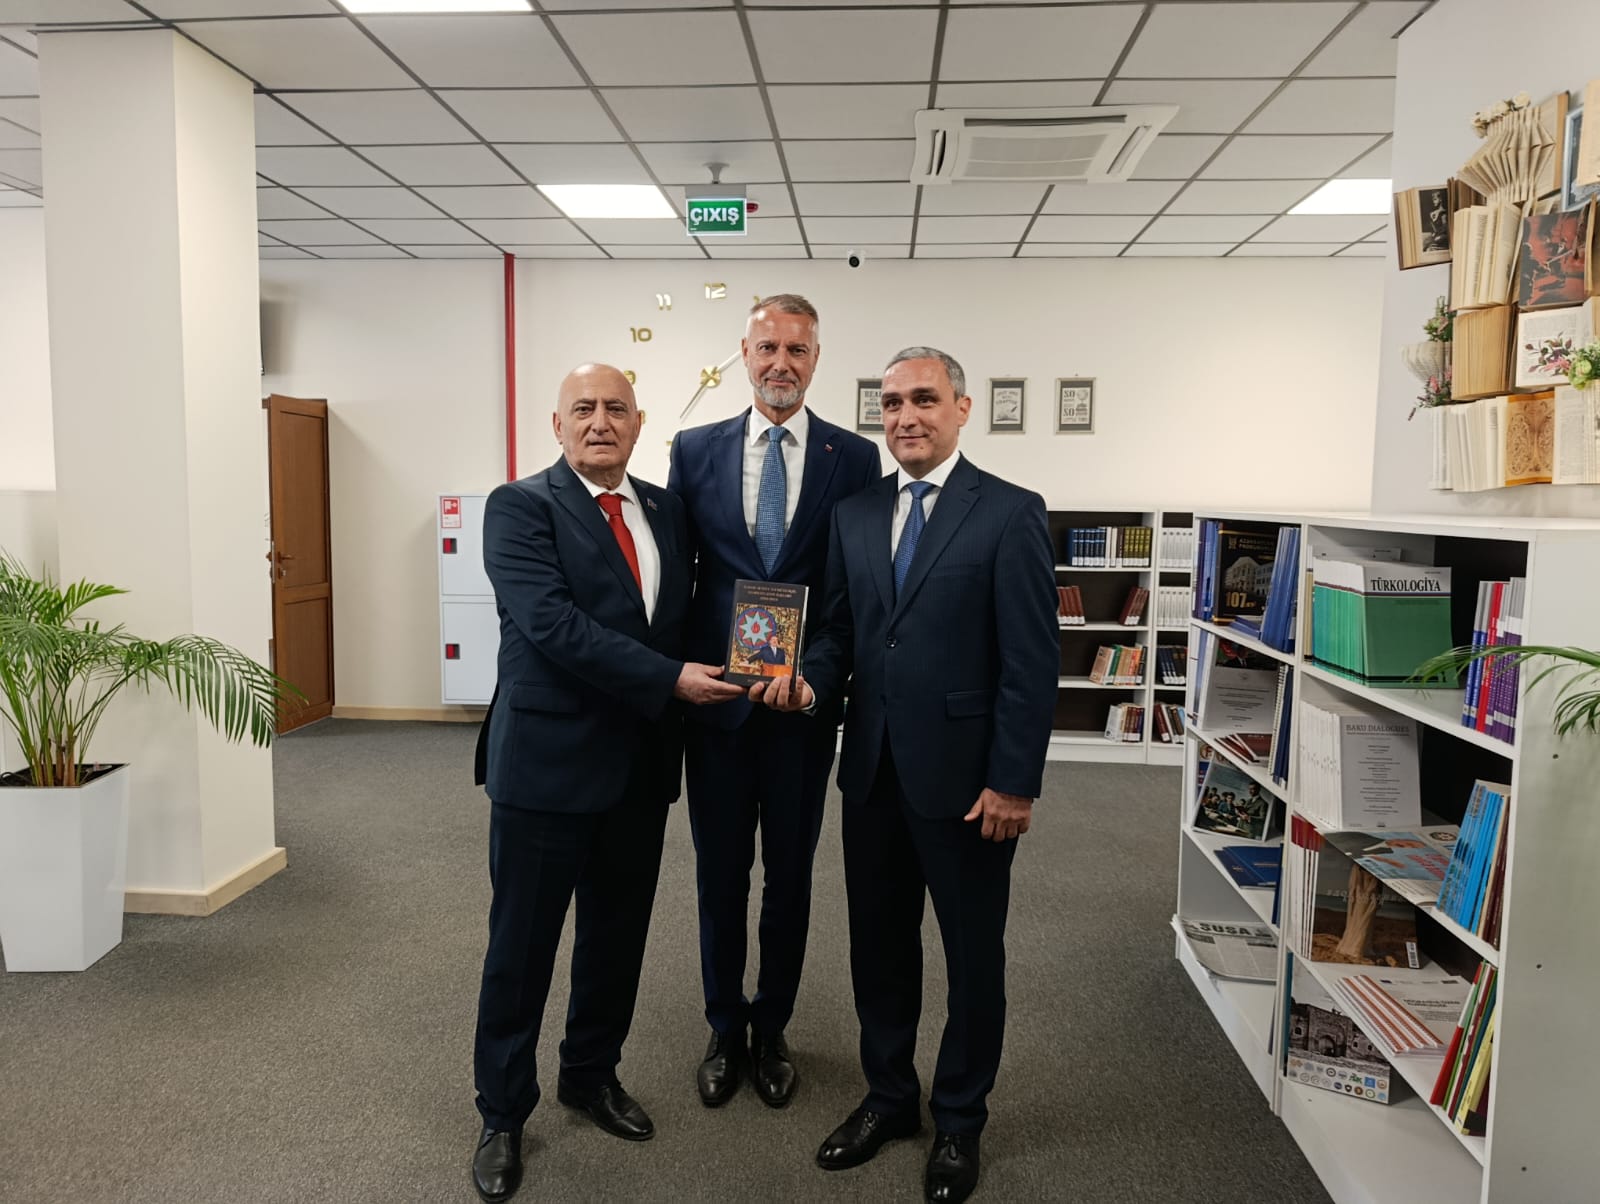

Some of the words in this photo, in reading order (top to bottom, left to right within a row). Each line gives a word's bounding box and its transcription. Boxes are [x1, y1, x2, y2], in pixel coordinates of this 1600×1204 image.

[690, 207, 740, 226] ÇIXIŞ
[704, 283, 727, 299] 12
[656, 294, 672, 311] 11
[630, 327, 652, 343] 10
[1371, 577, 1441, 592] TÜRKOLOGİYA
[1226, 591, 1247, 608] 107
